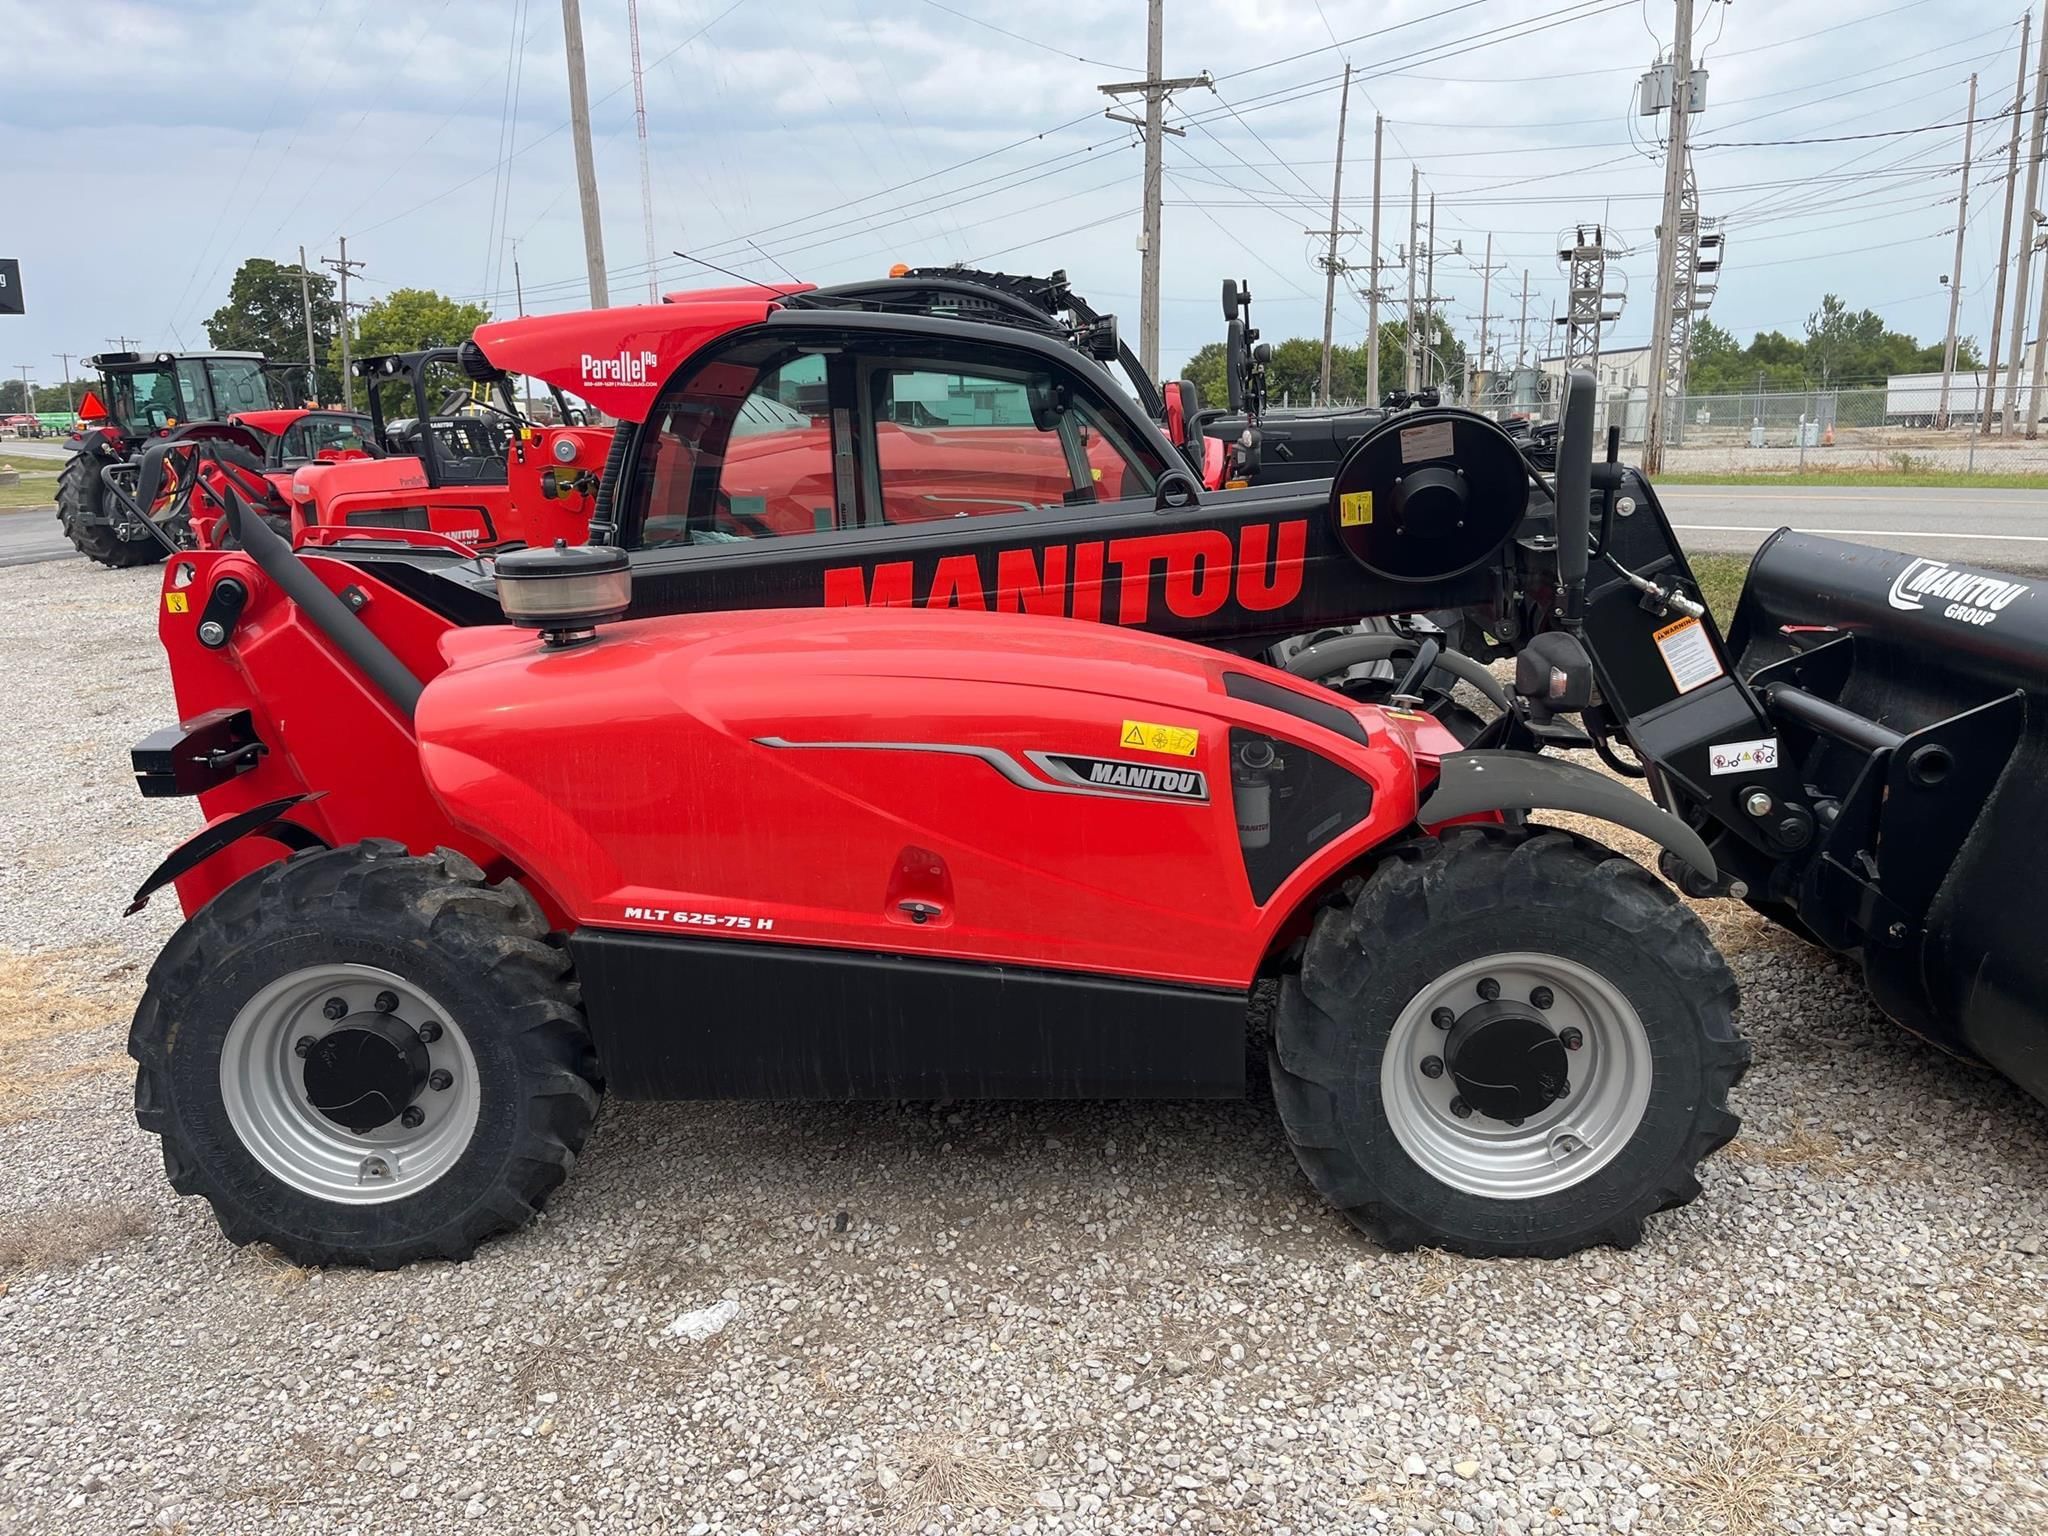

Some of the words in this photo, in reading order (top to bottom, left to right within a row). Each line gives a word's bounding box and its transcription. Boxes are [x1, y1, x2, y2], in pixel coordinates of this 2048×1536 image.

[1906, 566, 2030, 611] MANITOU
[1943, 603, 1997, 626] GROUP
[1089, 762, 1196, 793] MANITOU
[624, 907, 669, 921] MLT
[673, 911, 751, 929] 625-75
[756, 918, 774, 930] H
